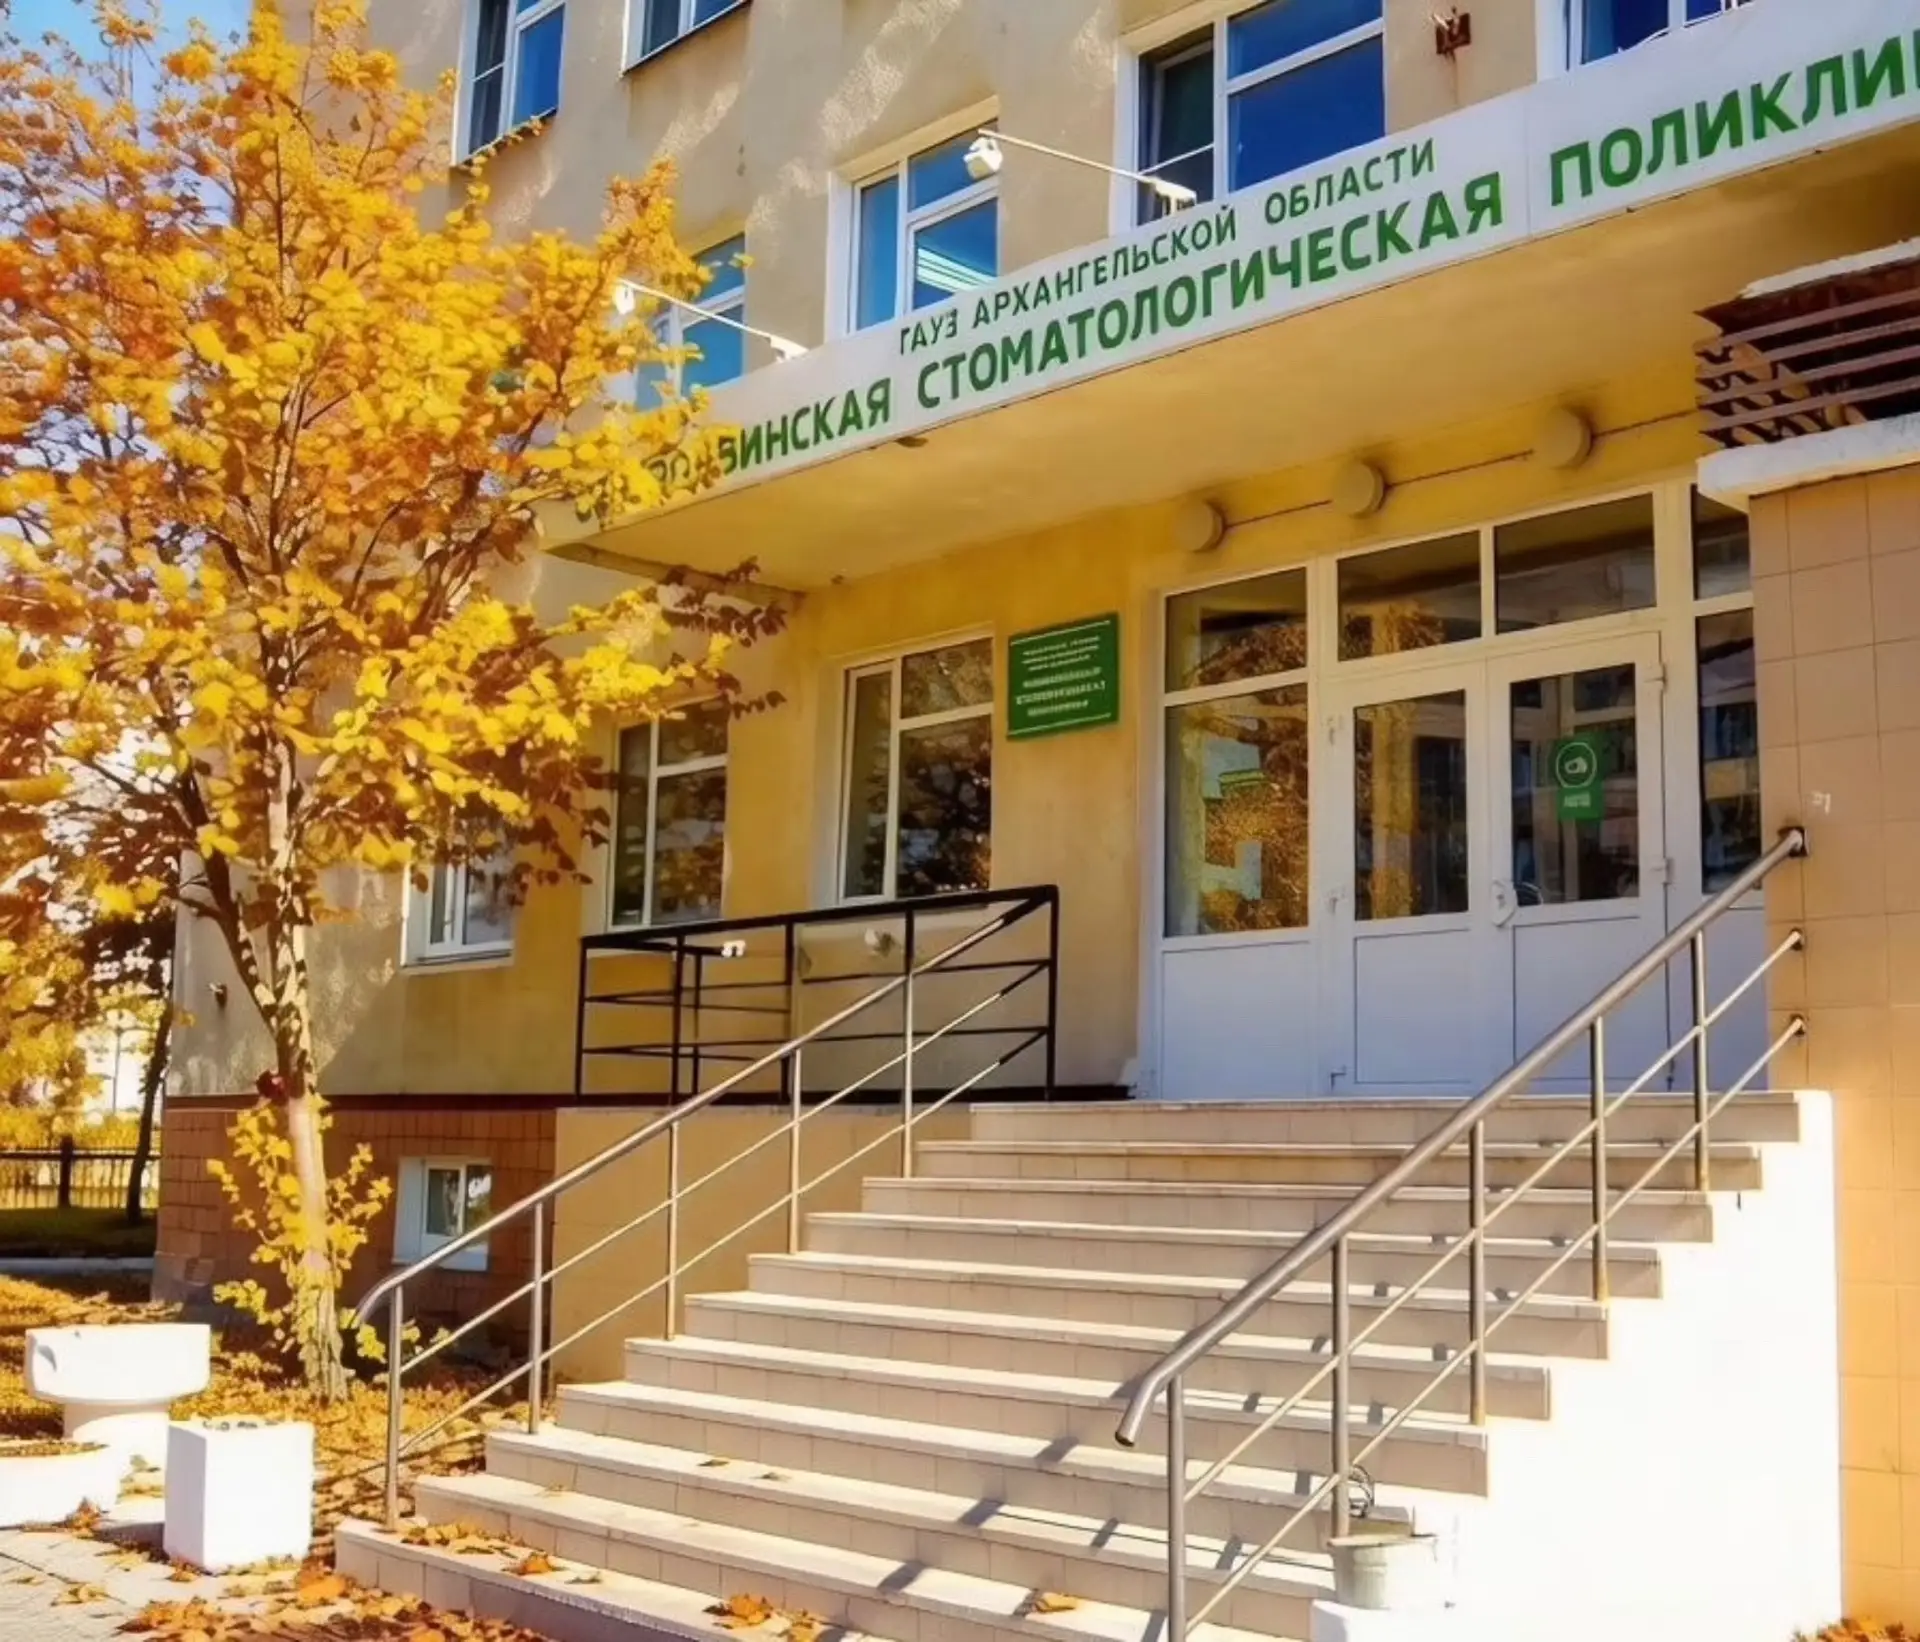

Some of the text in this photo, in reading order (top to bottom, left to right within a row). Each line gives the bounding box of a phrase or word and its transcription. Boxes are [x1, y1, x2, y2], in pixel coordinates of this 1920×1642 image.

[900, 138, 1435, 356] ГАУЗ АРХАНГЕЛЬСКОЙ ОБЛАСТИ
[917, 171, 1503, 409] СТОМАТОЛОГИЧЕСКАЯ
[1550, 28, 1920, 207] ПОЛИКЛИ
